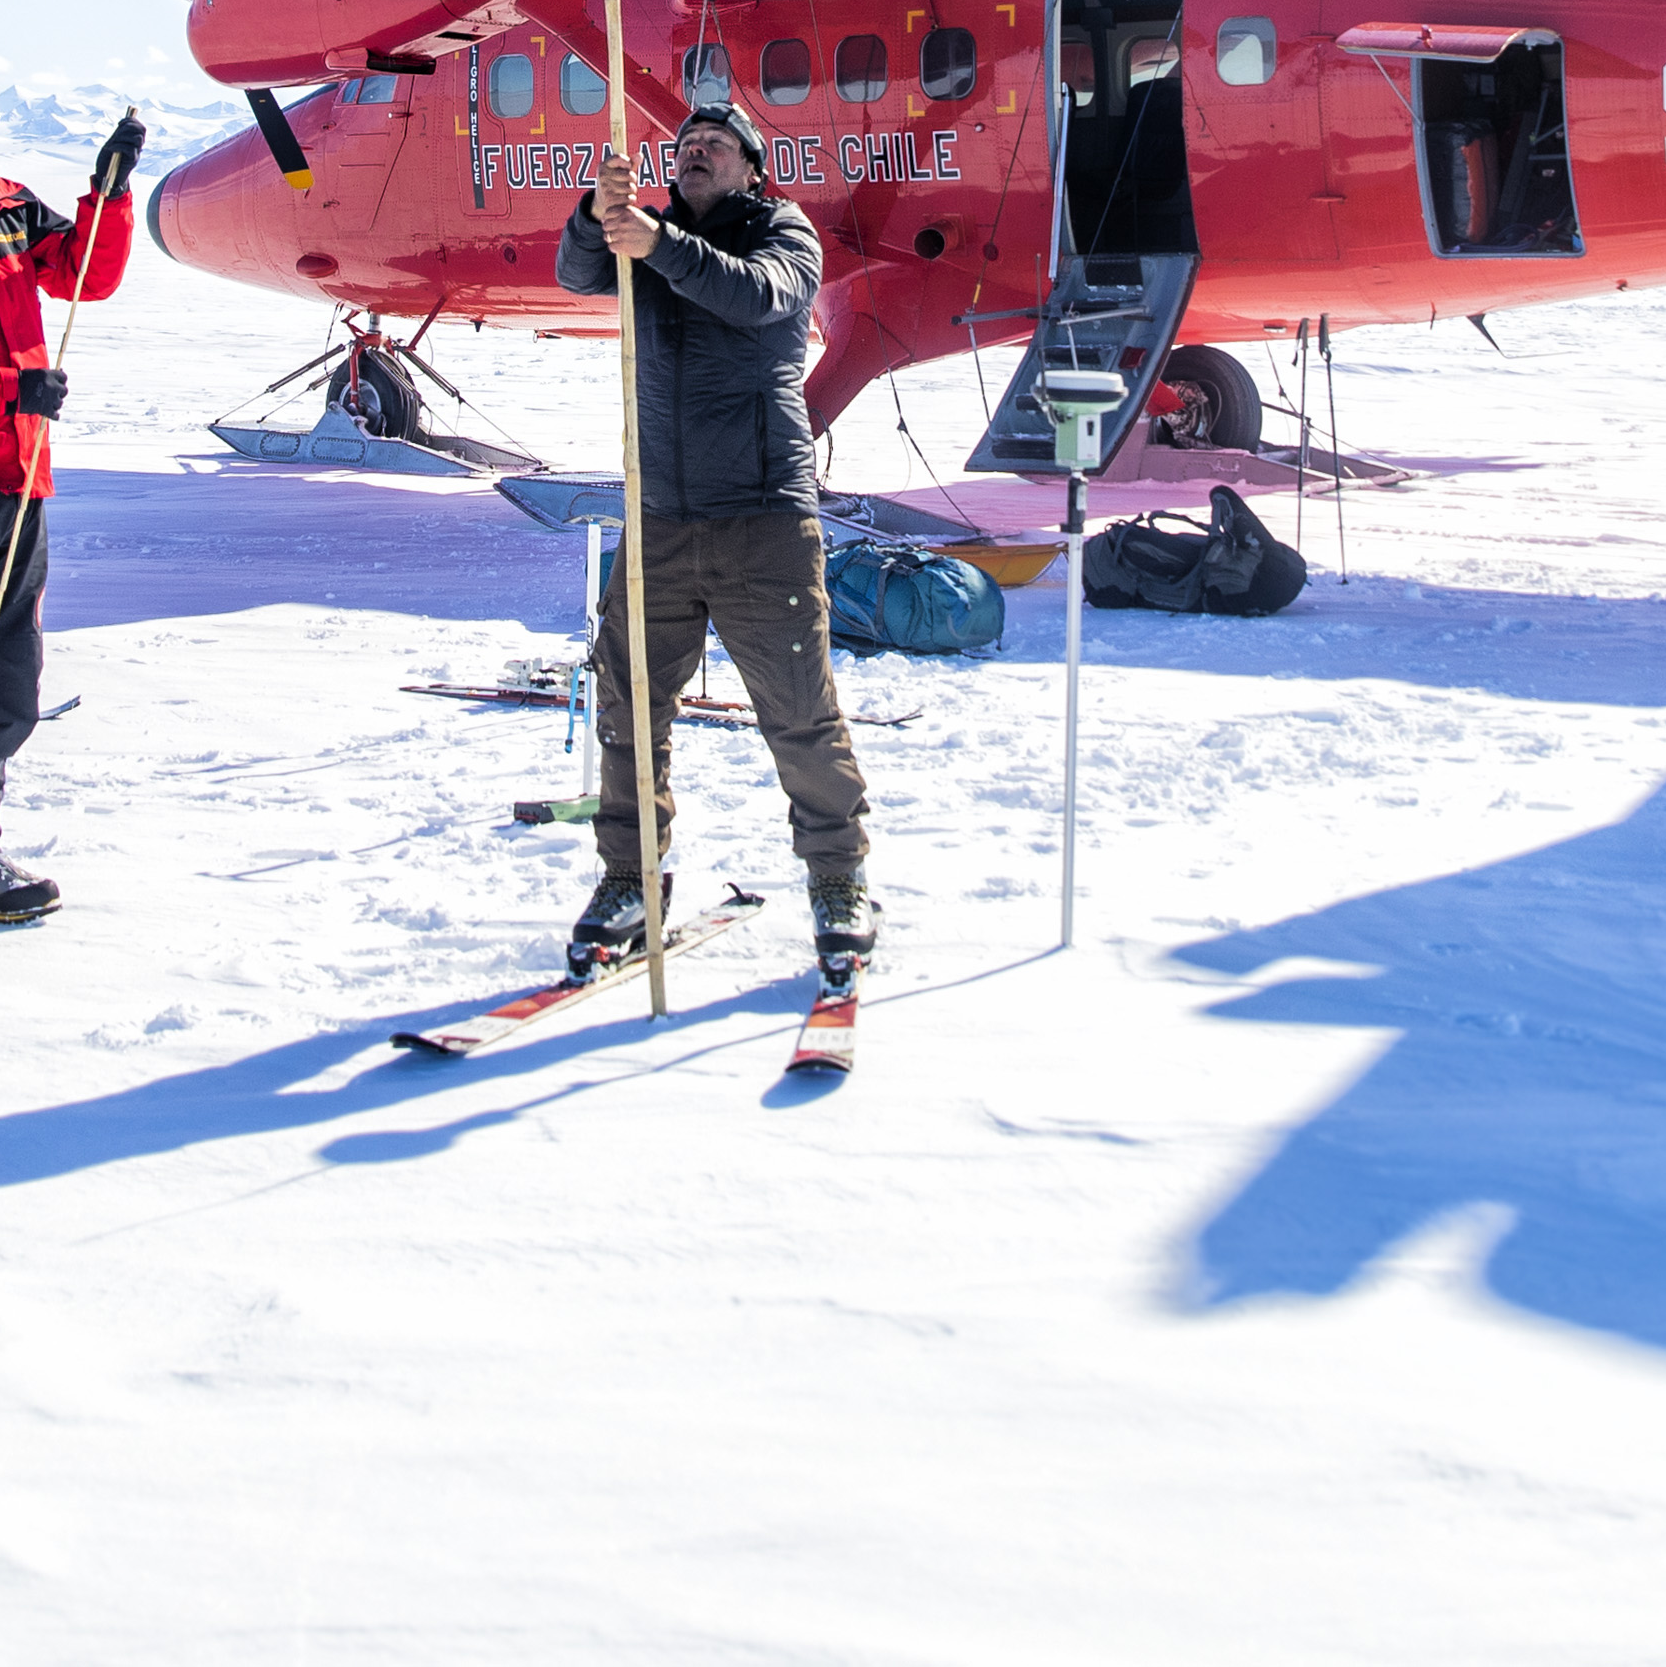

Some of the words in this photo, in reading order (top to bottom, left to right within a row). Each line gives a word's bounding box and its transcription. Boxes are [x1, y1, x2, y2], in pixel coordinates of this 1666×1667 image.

[469, 44, 478, 102] LIGRO
[470, 111, 481, 184] HELICE
[482, 142, 613, 190] FUERZ
[772, 136, 825, 185] DE
[838, 130, 961, 183] CHILE
